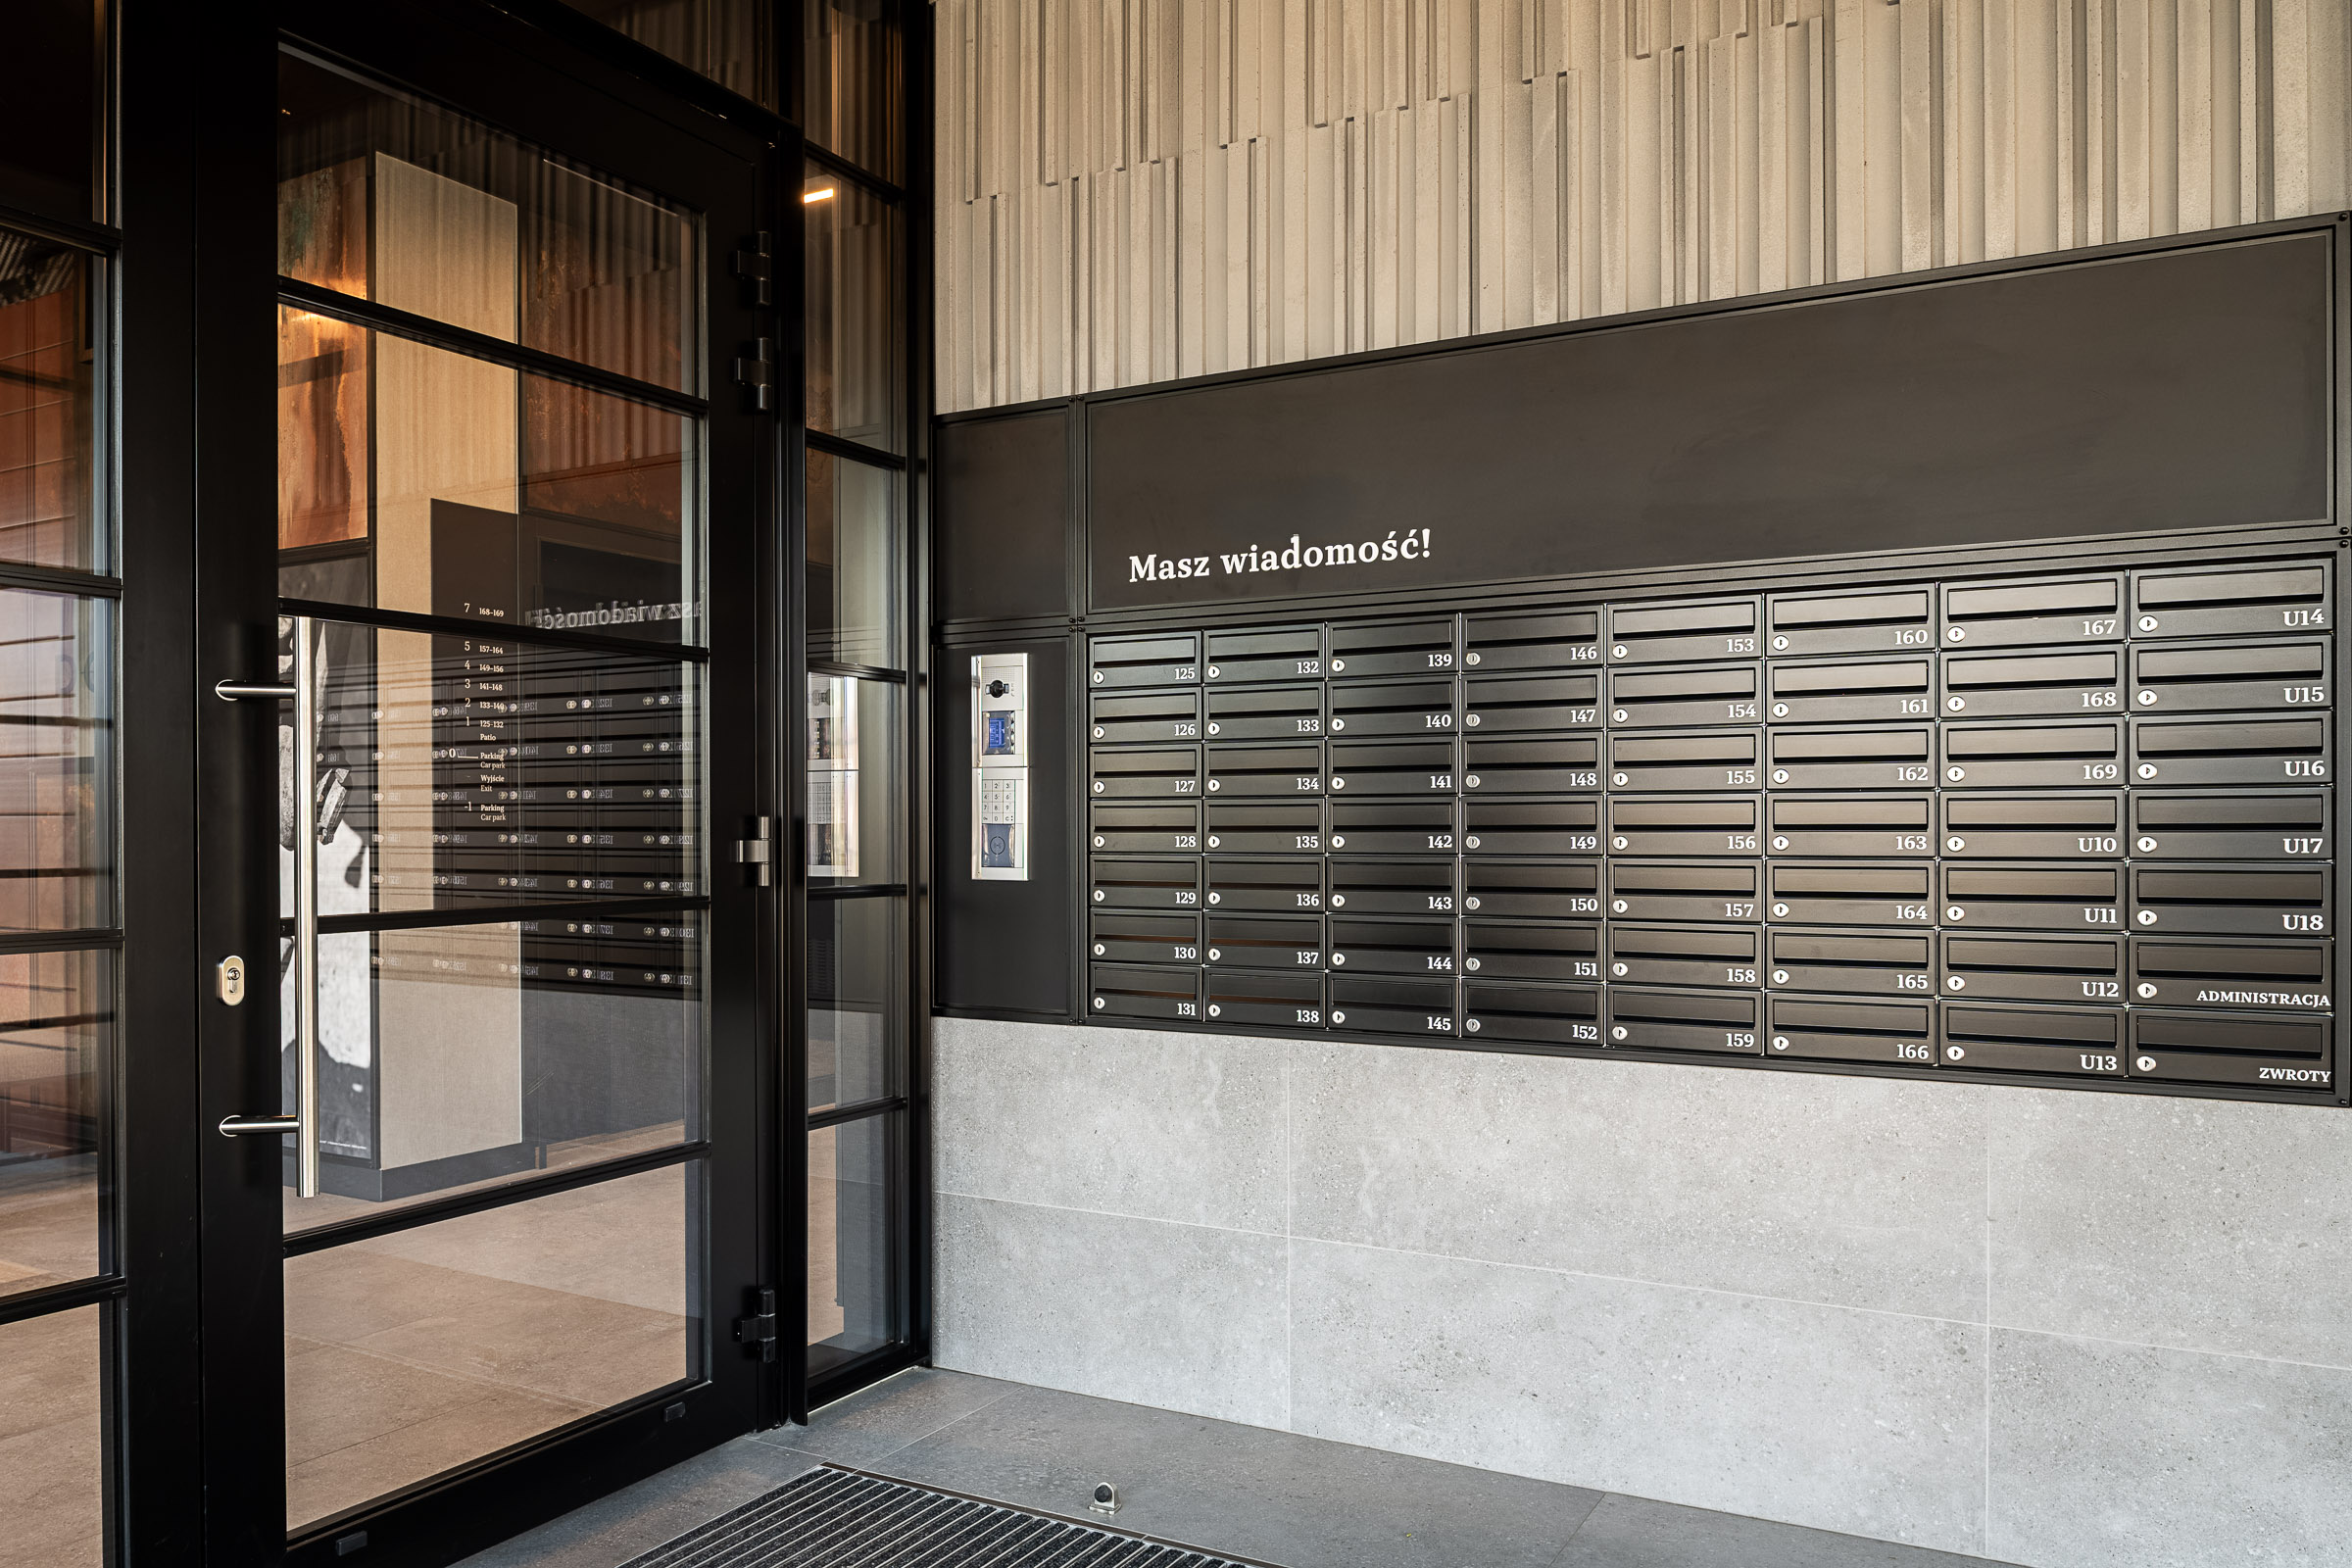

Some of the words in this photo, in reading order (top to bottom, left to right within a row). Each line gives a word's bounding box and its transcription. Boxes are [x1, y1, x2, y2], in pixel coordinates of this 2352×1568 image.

[1129, 555, 1209, 582] Masz
[1220, 529, 1430, 573] wiadomość!
[464, 603, 470, 612] 7
[2283, 609, 2324, 626] U14
[2083, 620, 2116, 635] 167
[1895, 630, 1928, 644] 160
[465, 641, 470, 651] 5
[1727, 639, 1753, 652] 153
[1428, 654, 1451, 666] 139
[1571, 647, 1596, 660] 146
[465, 661, 470, 669] 4
[1298, 662, 1318, 673] 132
[1175, 667, 1195, 679] 125
[465, 679, 470, 689] 3
[2082, 692, 2116, 707] 168
[2284, 687, 2324, 703] U15
[465, 698, 471, 708] 2
[1901, 700, 1928, 712] 161
[1571, 710, 1595, 722] 147
[1728, 704, 1756, 717] 154
[466, 716, 470, 726] 1
[1298, 720, 1319, 731] 133
[1426, 714, 1451, 727] 140
[1175, 724, 1195, 735] 126
[449, 748, 457, 759] 0
[480, 753, 504, 761] Parking
[1897, 767, 1928, 780] 162
[2083, 764, 2117, 779] 169
[2284, 760, 2325, 776] U16
[1431, 776, 1451, 788] 141
[1571, 773, 1596, 786] 148
[1727, 770, 1754, 784] 155
[1175, 781, 1195, 792] 127
[1297, 778, 1319, 790] 134
[480, 805, 505, 813] Parking
[493, 814, 507, 823] park
[1175, 836, 1196, 847] 128
[1297, 836, 1318, 848] 135
[1428, 836, 1451, 848] 142
[1571, 837, 1596, 849] 149
[1728, 836, 1755, 849] 156
[1896, 836, 1927, 850] 163
[2079, 837, 2116, 852] U10
[2283, 839, 2323, 854] U17
[1176, 892, 1196, 904] 129
[1297, 894, 1319, 906] 136
[1429, 897, 1451, 909] 143
[1571, 899, 1597, 911] 150
[1726, 904, 1753, 916] 157
[1896, 906, 1928, 919] 164
[2084, 908, 2117, 923] U11
[2282, 915, 2324, 930] U18
[1175, 947, 1196, 958] 130
[1298, 952, 1318, 963] 137
[1428, 956, 1451, 969] 144
[1575, 962, 1596, 976] 151
[1728, 969, 1755, 982] 158
[1897, 975, 1928, 989] 165
[2082, 982, 2118, 997] U12
[2197, 991, 2330, 1007] ADMINISTRACJA
[1178, 1004, 1196, 1015] 131
[1297, 1010, 1319, 1022] 138
[1428, 1017, 1450, 1030] 145
[1573, 1025, 1597, 1040] 152
[1727, 1034, 1754, 1047] 159
[1897, 1045, 1929, 1059] 166
[2081, 1054, 2117, 1070] U13
[2260, 1068, 2330, 1082] ZWROTY
